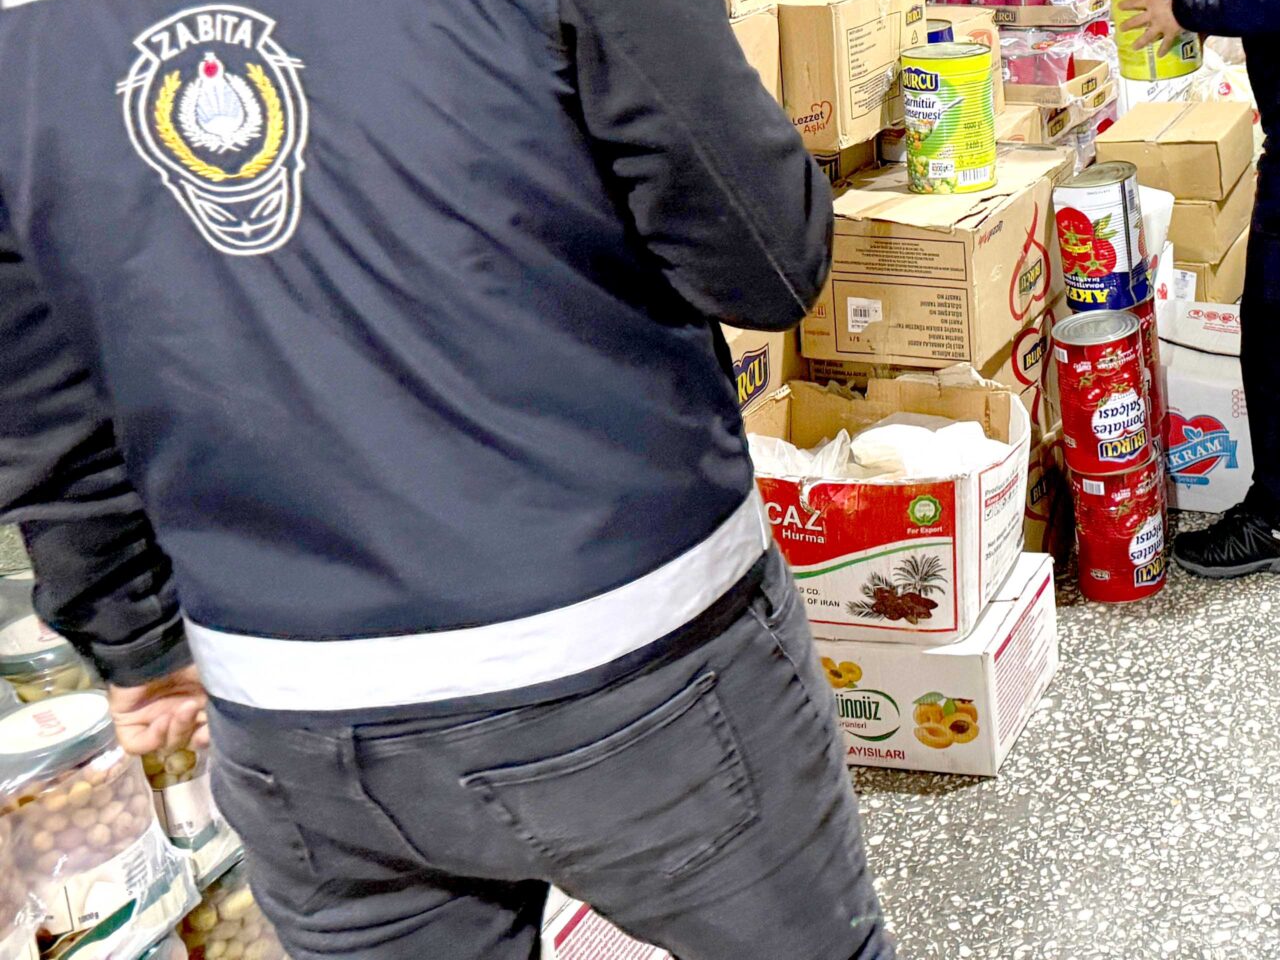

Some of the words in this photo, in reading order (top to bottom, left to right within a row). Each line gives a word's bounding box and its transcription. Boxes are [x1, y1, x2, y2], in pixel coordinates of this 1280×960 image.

[994, 11, 1016, 21] URCU
[151, 13, 253, 61] ZABITA
[904, 96, 937, 109] arnitür
[792, 110, 825, 127] Lezzet
[803, 123, 826, 136] Aşkı
[1097, 397, 1142, 420] Salçası
[1092, 411, 1145, 435] Domates
[1102, 431, 1146, 457] BURCU
[1167, 438, 1221, 467] KRAM
[766, 501, 824, 532] CAZ
[782, 528, 825, 544] Hurma
[906, 526, 919, 535] For
[920, 525, 943, 535] Export
[807, 598, 818, 606] OF
[819, 598, 840, 608] IRAN
[838, 720, 867, 730] rünleri
[848, 744, 906, 760] AYISILARI
